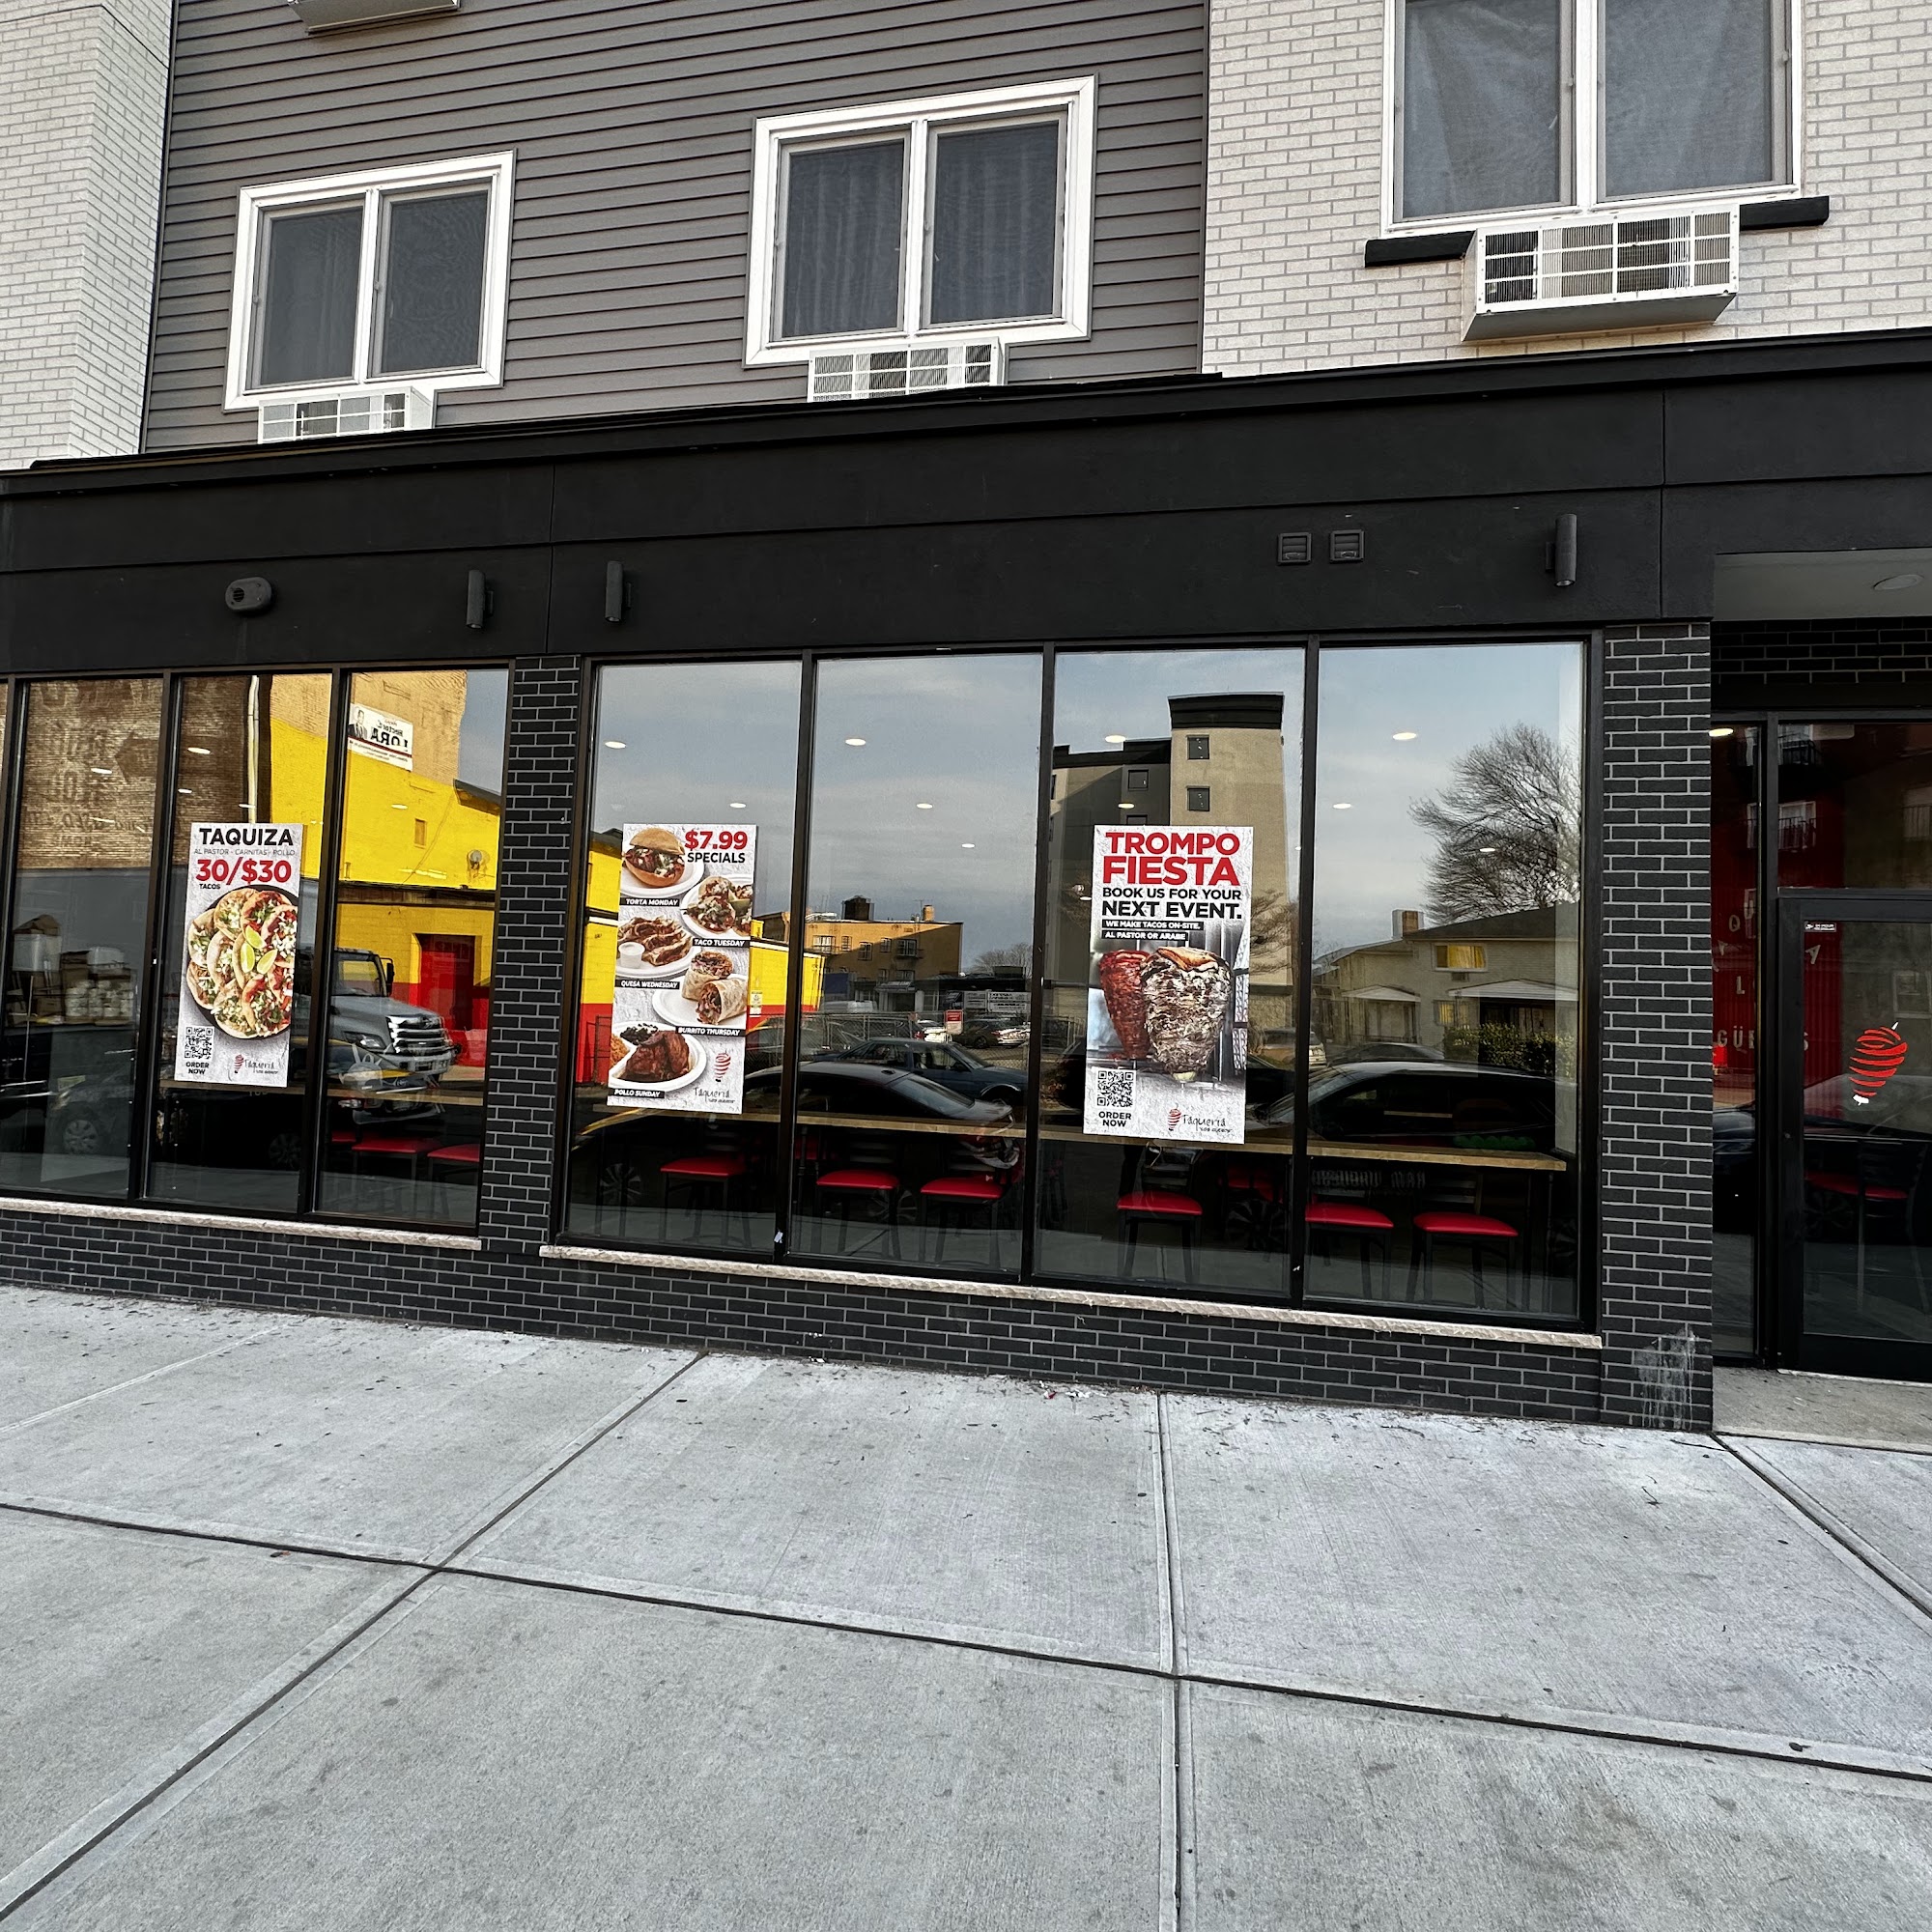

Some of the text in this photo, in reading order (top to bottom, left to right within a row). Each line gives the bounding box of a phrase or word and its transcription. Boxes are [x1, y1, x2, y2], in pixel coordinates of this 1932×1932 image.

[198, 828, 294, 846] TAQUIZA
[684, 829, 748, 851] $7.99
[1105, 832, 1240, 856] TROMPO
[687, 852, 746, 864] SPECIALS
[195, 856, 292, 885] 30/$30
[1102, 855, 1241, 886] FIESTA
[1102, 887, 1242, 900] BOOK US FOR YOUR
[1101, 900, 1242, 920] NEXT EVENT.
[1098, 1111, 1132, 1120] ORDER
